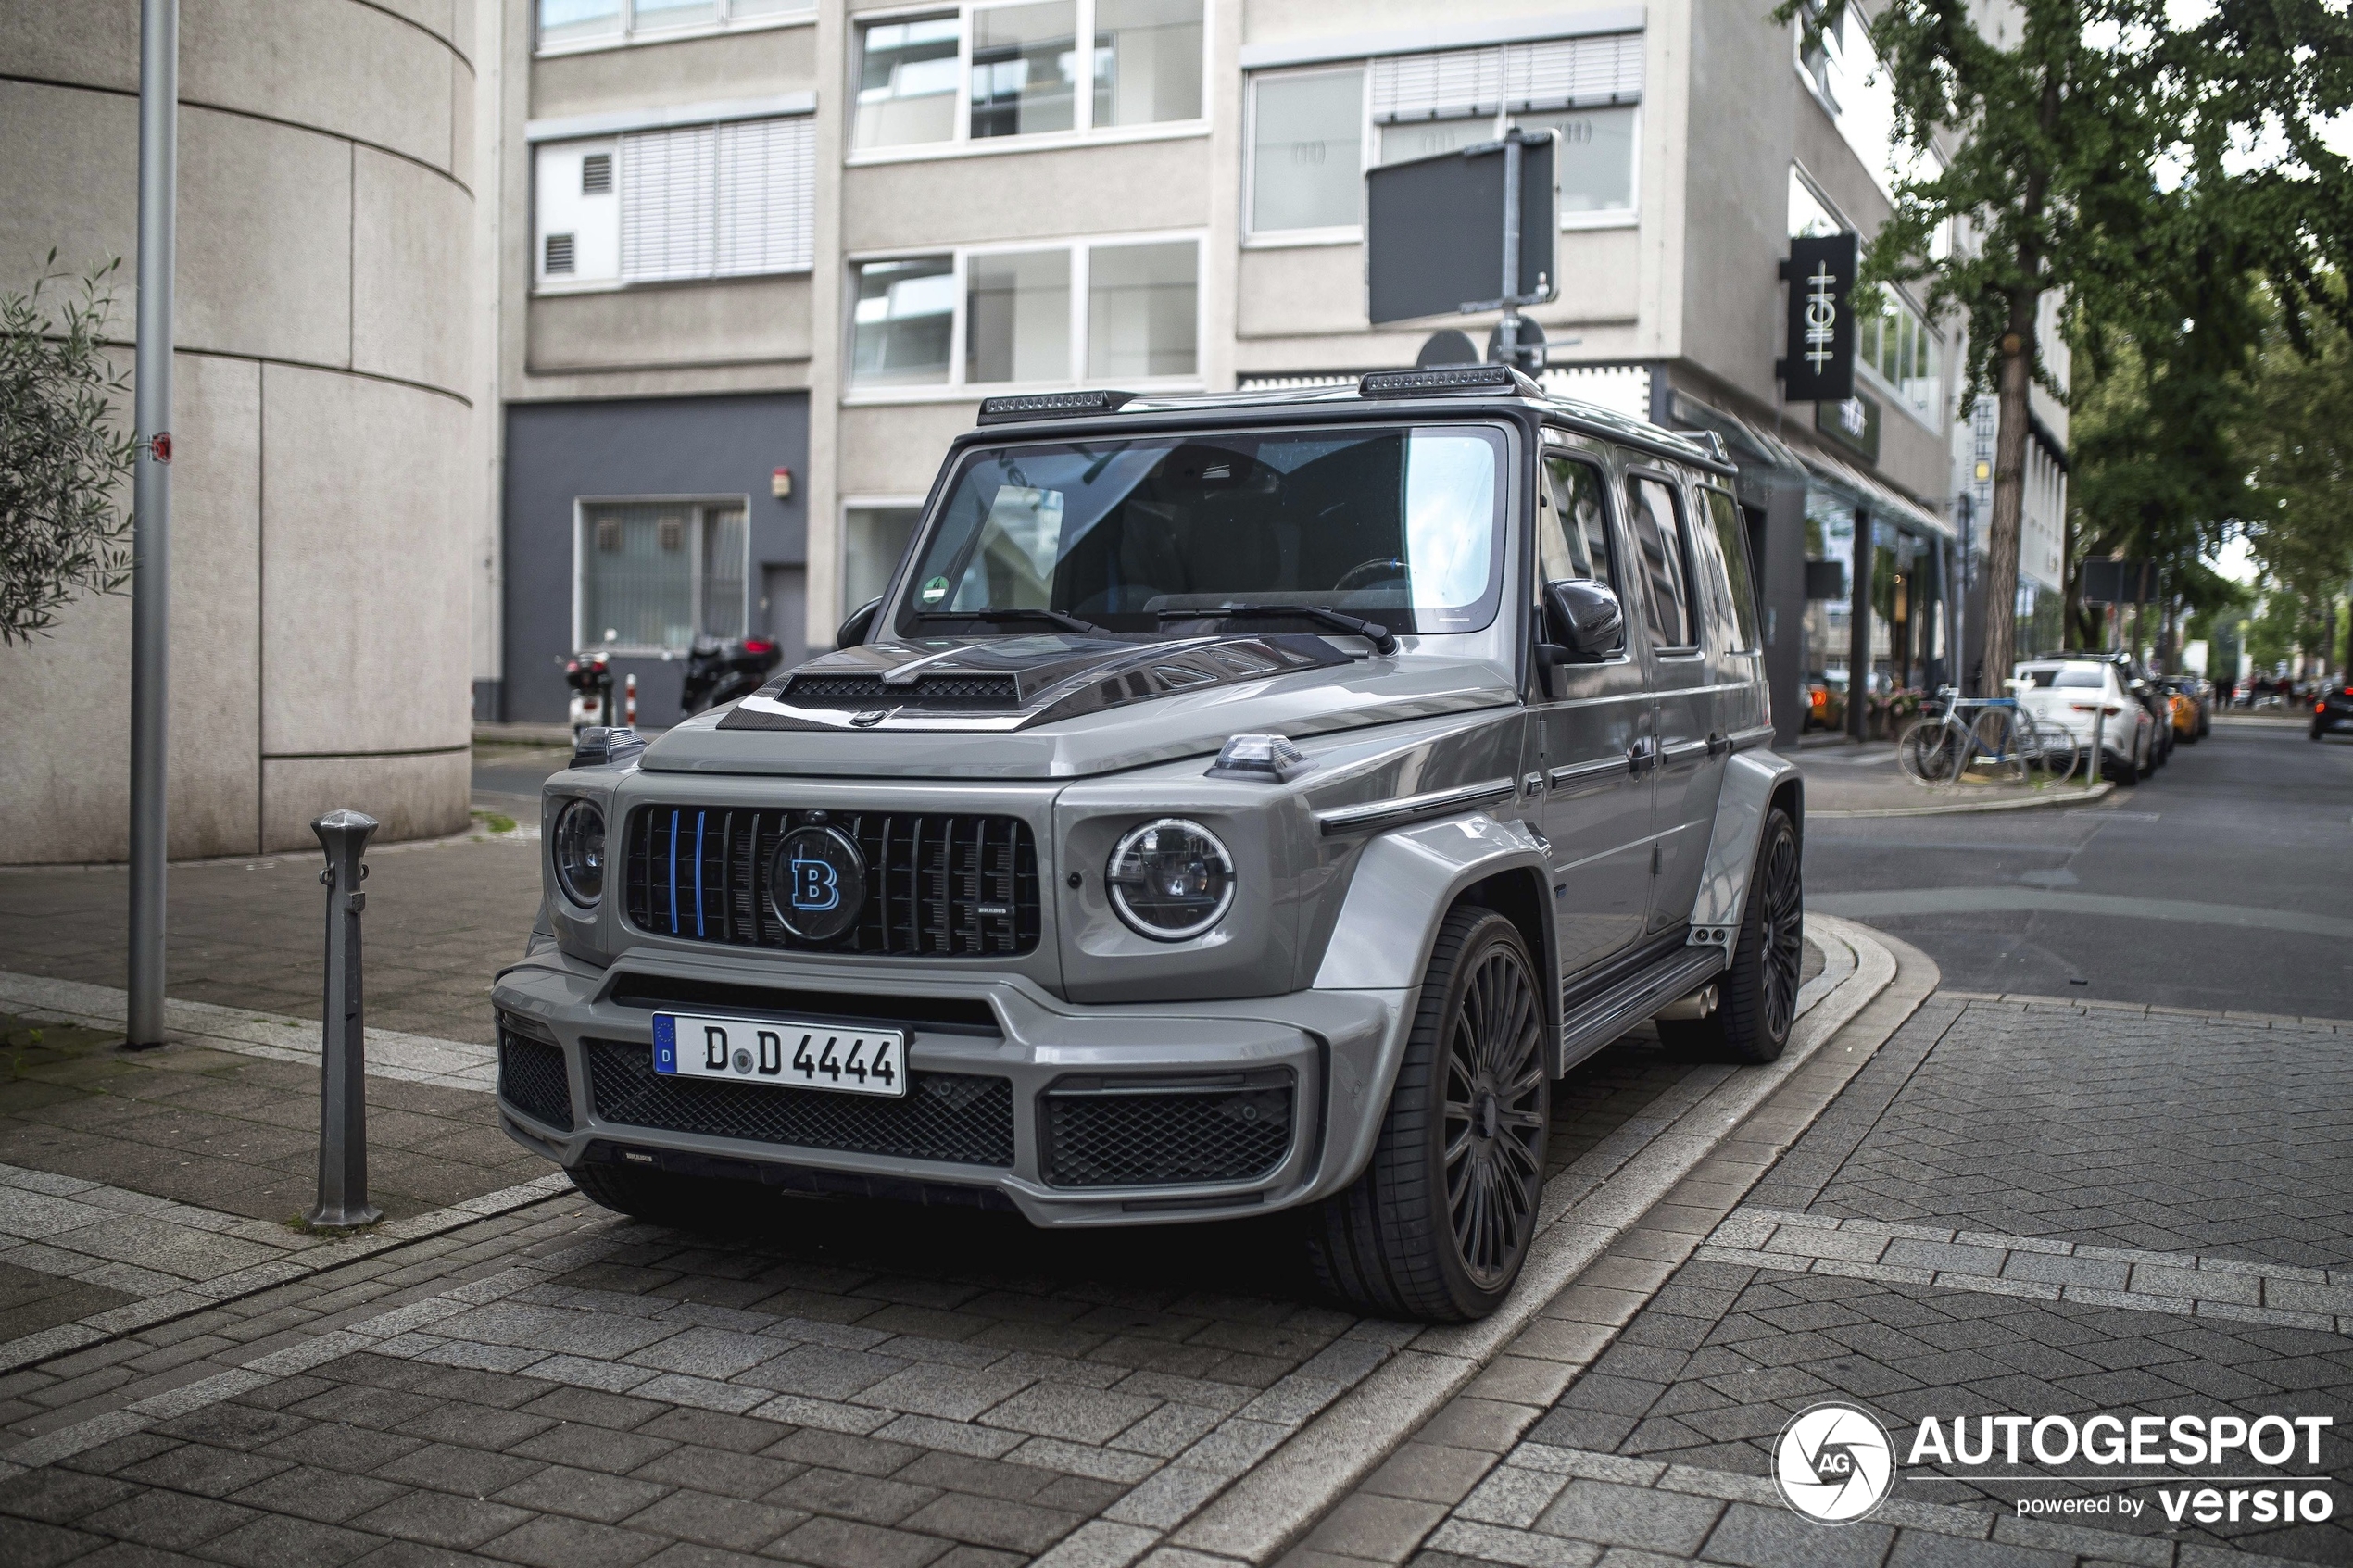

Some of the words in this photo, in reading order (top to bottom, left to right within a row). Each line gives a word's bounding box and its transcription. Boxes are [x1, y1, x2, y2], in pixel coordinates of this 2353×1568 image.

[932, 576, 941, 589] 4
[792, 859, 840, 910] B
[661, 1048, 672, 1063] D
[792, 1034, 896, 1086] 4444
